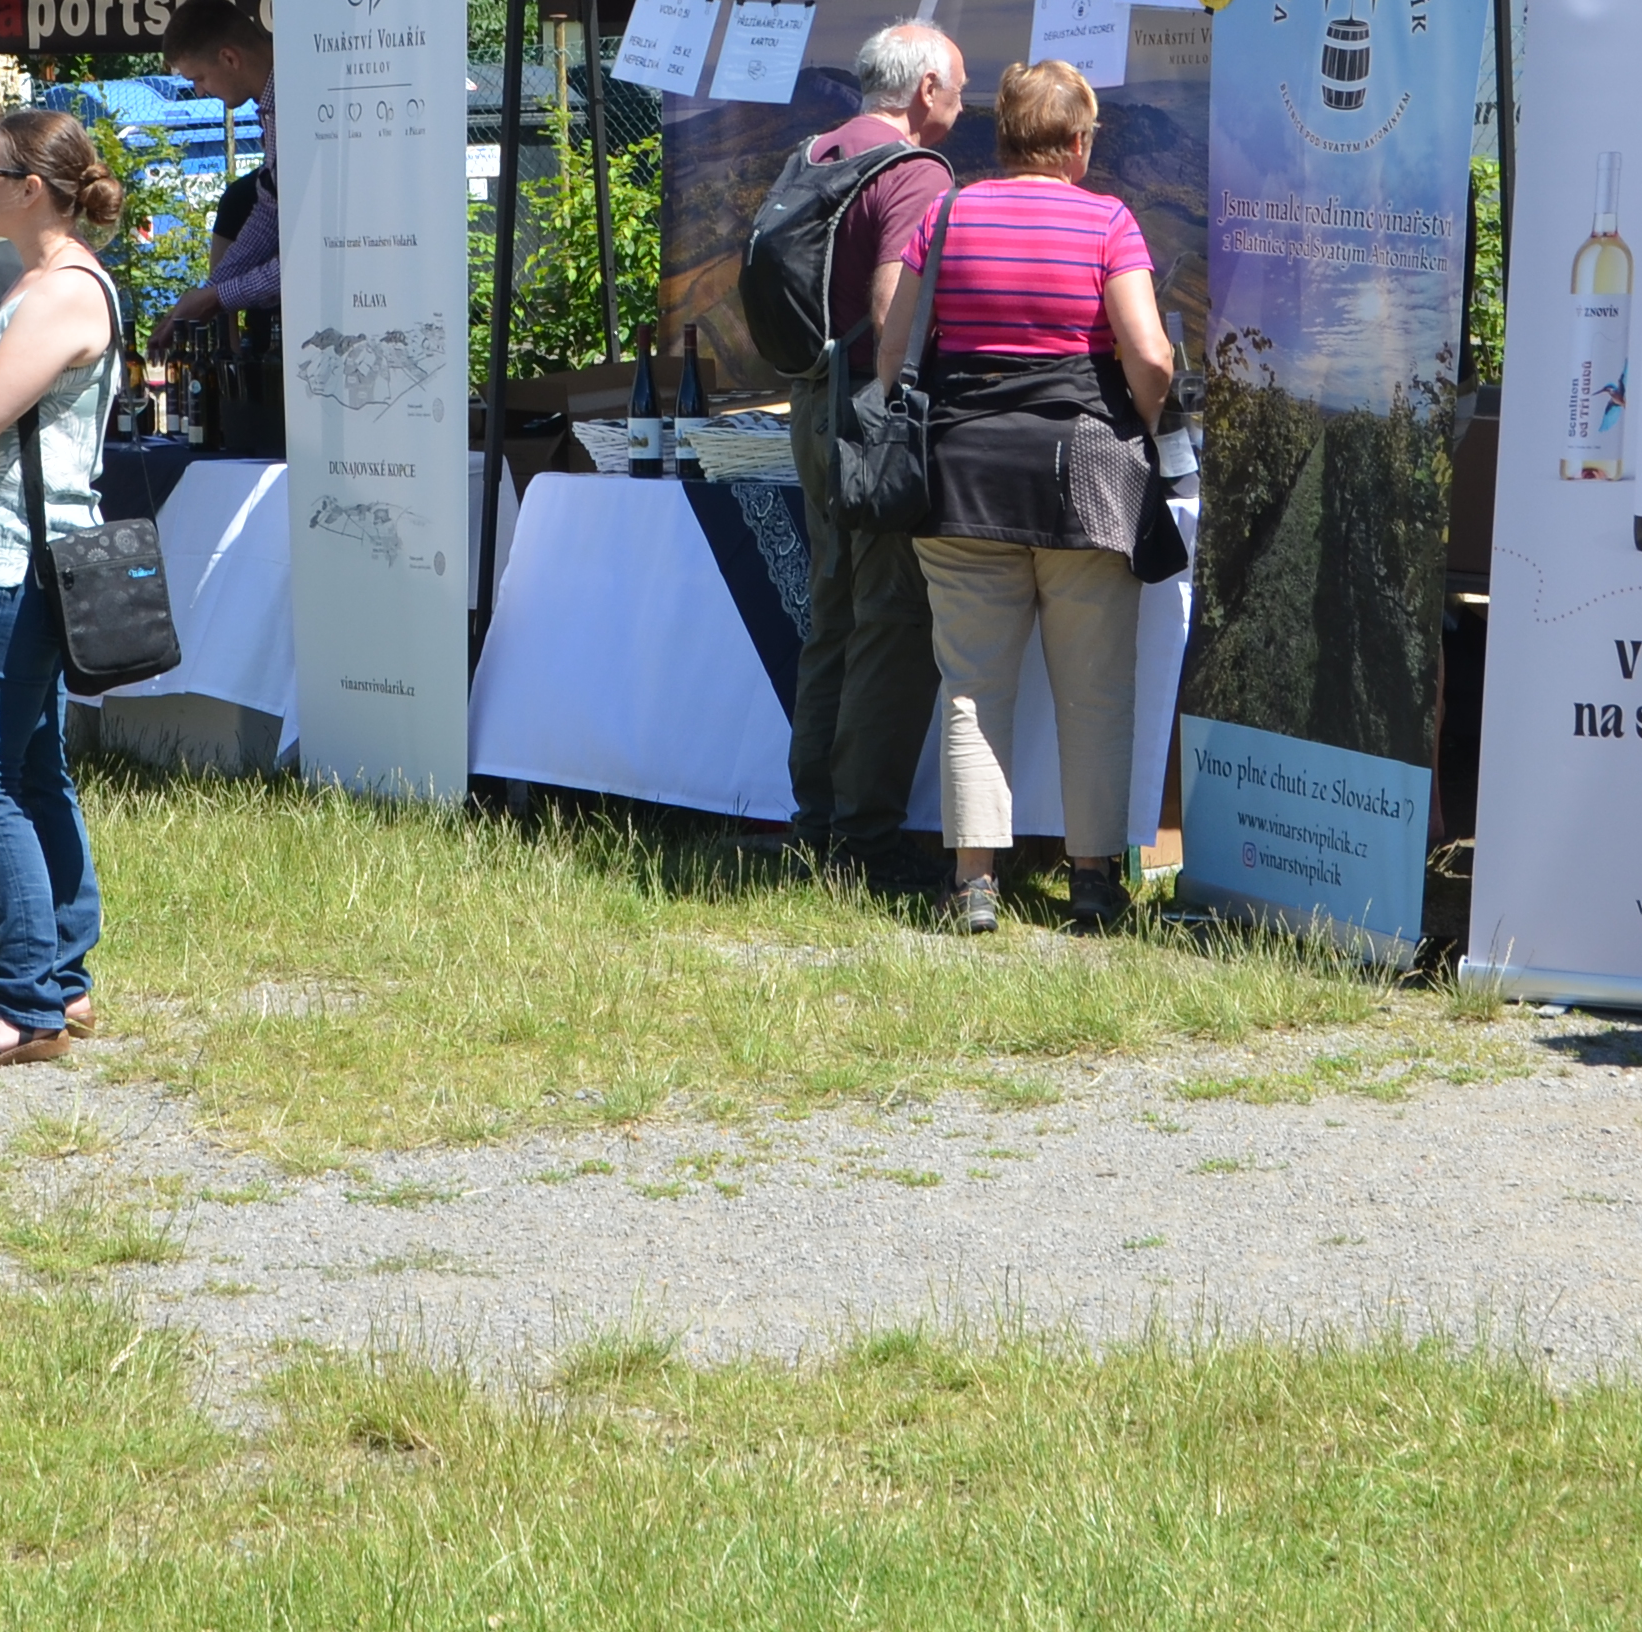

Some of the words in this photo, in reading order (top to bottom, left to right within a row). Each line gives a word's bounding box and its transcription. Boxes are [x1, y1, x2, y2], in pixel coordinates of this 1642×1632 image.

[345, 60, 392, 76] MIKULOV
[1168, 54, 1210, 65] MIKULO
[1304, 130, 1321, 147] POD
[1323, 140, 1361, 153] SVATÝM
[1217, 190, 1259, 225] Jsme
[1233, 230, 1286, 254] Blatnice
[1288, 235, 1311, 264] pod
[352, 290, 388, 308] PÁLAVA
[1583, 304, 1620, 318] ZNOVÍN
[328, 459, 386, 480] DUNAJOVSKÉ
[387, 461, 417, 479] KOPCE
[1573, 701, 1625, 739] na
[1193, 747, 1233, 778] Víno
[1236, 756, 1267, 790] plné
[1269, 763, 1308, 798] chuti
[1311, 781, 1328, 801] ze
[1330, 778, 1402, 820] Slovácka
[1237, 810, 1369, 859] www.vinarstvipilcik.cz
[1258, 844, 1343, 887] vinarstvipilcik
